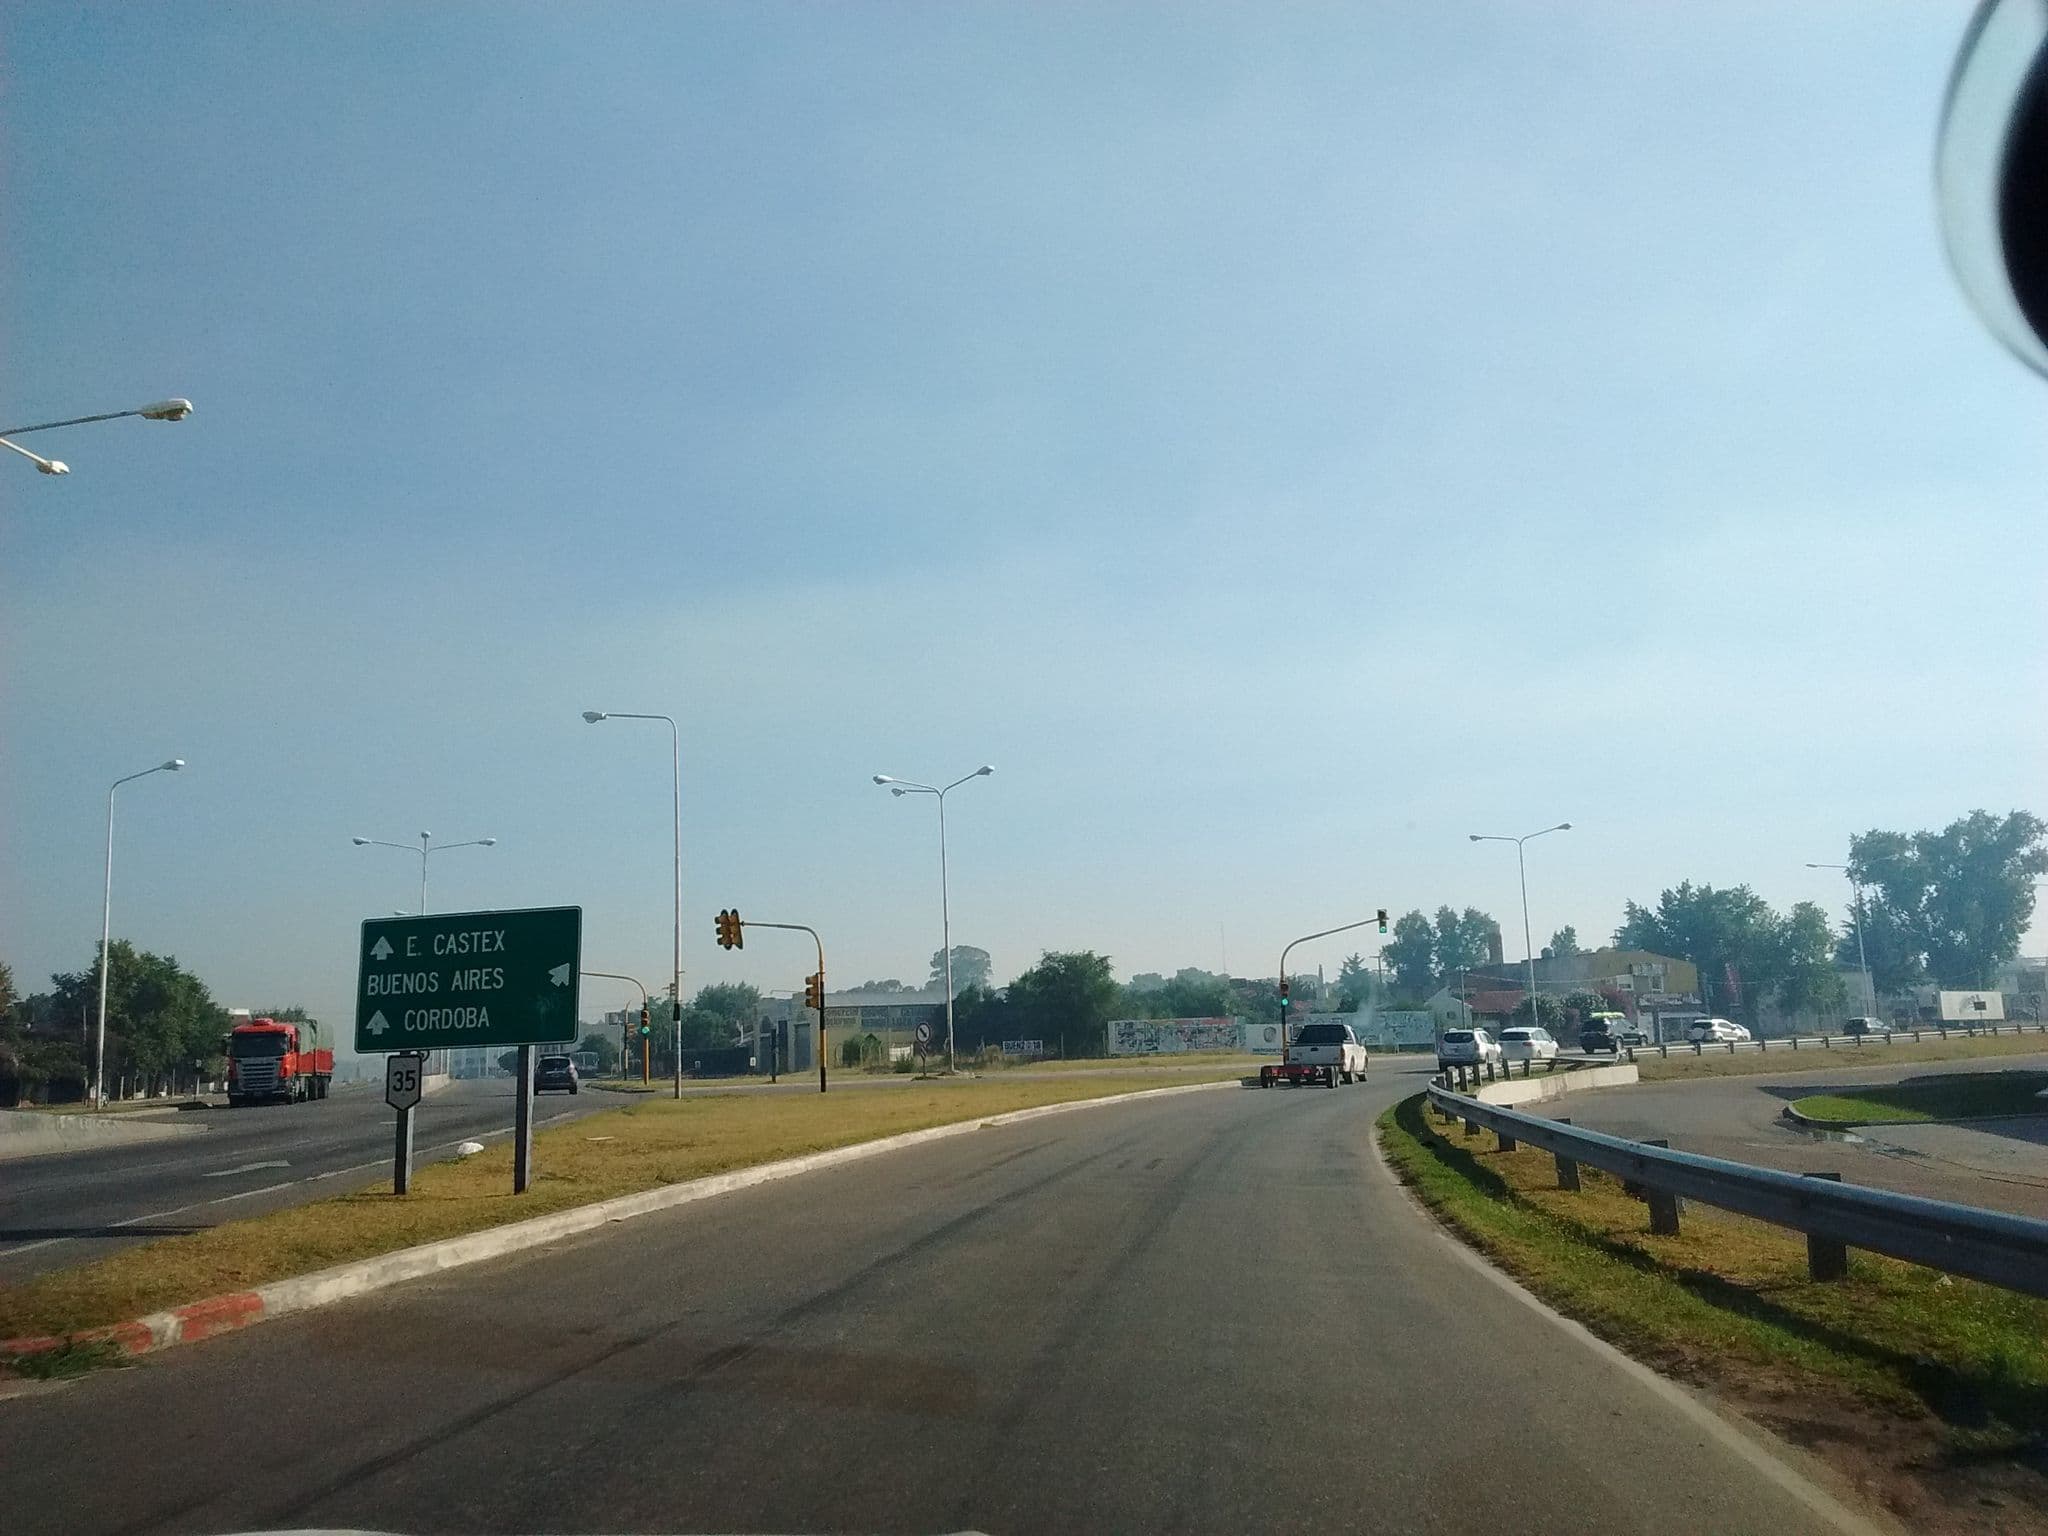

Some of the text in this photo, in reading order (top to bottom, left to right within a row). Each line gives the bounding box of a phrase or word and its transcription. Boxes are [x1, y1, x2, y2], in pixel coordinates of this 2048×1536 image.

[406, 930, 505, 957] E. CASTEX
[367, 968, 504, 996] BUENOS AIRES
[404, 1006, 490, 1031] CORDOBA
[392, 1070, 416, 1092] 35
